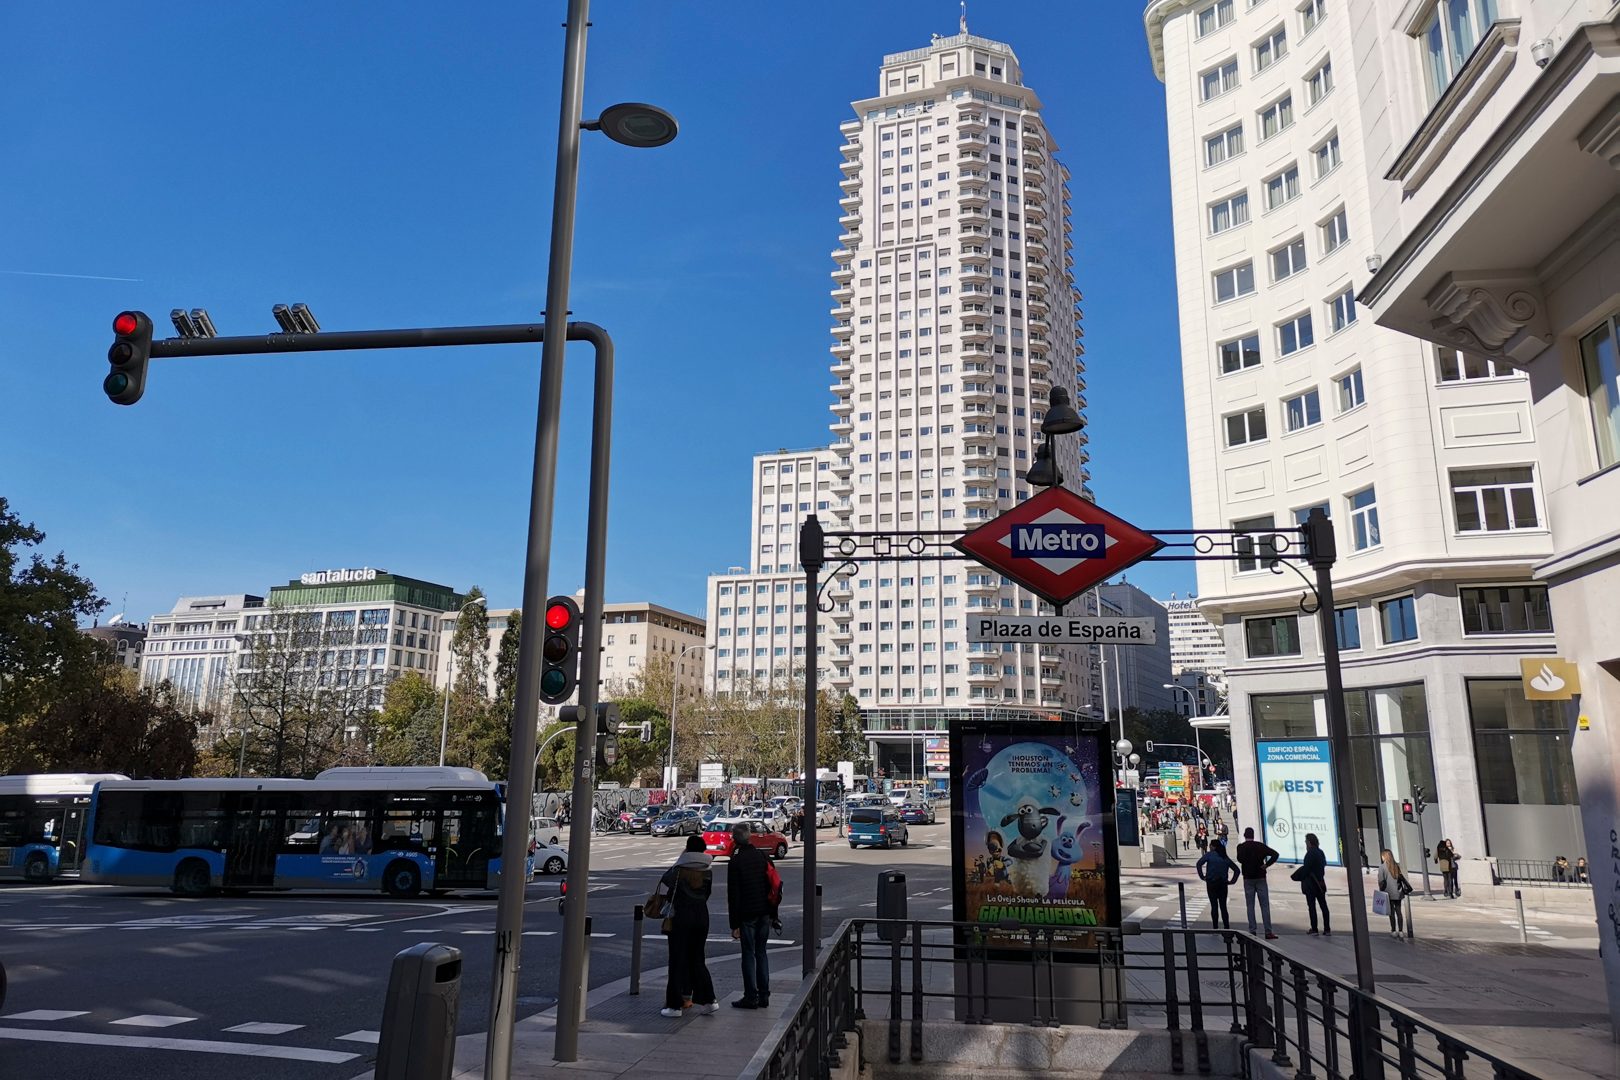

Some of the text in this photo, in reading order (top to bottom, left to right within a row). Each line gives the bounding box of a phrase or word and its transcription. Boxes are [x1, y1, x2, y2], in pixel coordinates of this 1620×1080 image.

[1018, 528, 1099, 551] Metro
[300, 566, 376, 585] santalucia
[1168, 601, 1193, 610] Hotel
[980, 620, 1141, 641] Plaza de España
[1269, 780, 1324, 793] INBEST
[987, 894, 1085, 906] La Oveja Shaun LA PELÍCULA
